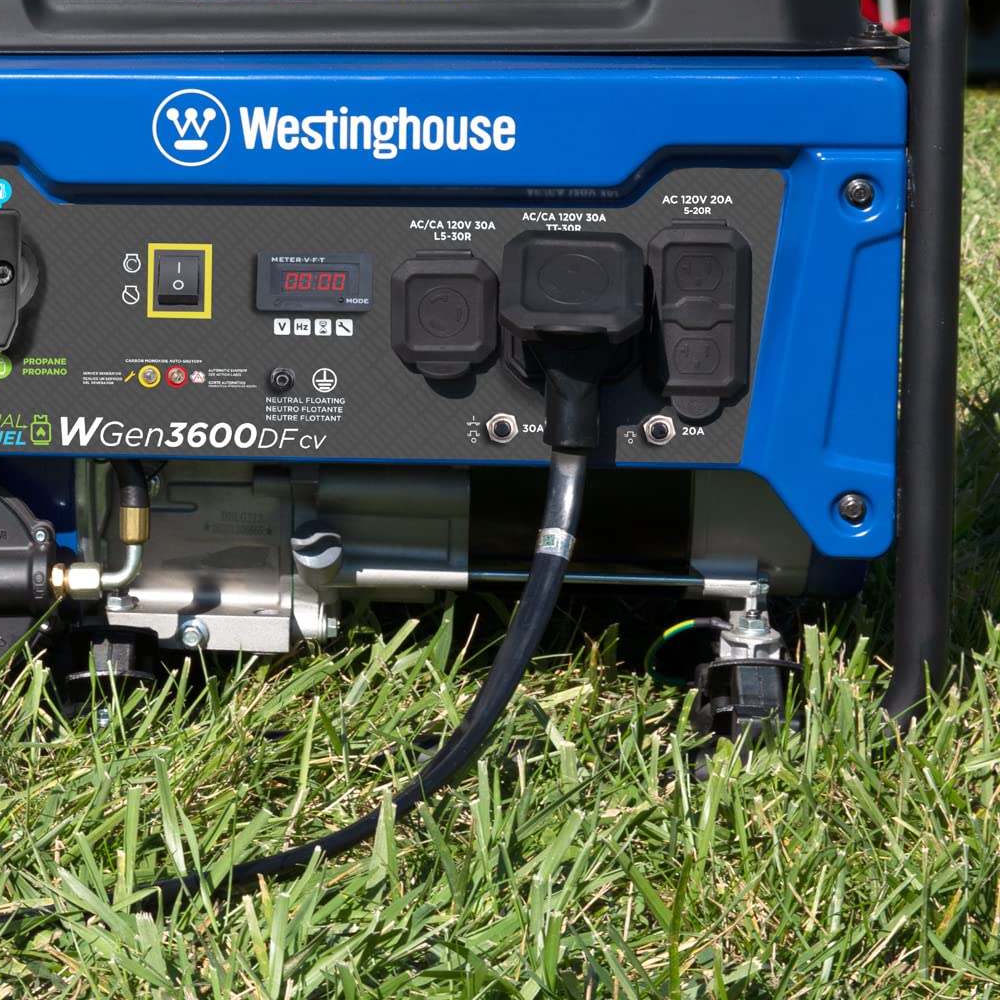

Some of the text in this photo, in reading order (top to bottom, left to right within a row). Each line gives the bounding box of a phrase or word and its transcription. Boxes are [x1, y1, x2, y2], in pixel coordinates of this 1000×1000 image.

[240, 106, 516, 159] Westinghouse
[662, 195, 733, 204] AC 120V 20A
[684, 207, 711, 215] 5-20R
[522, 211, 606, 222] AC/CA 120V 30A
[410, 220, 496, 230] AC/CA 120V 30A
[546, 224, 582, 232] TT-30R
[434, 232, 472, 241] L5-30R
[278, 322, 286, 331] V
[296, 323, 308, 331] Hz
[522, 424, 544, 433] 30A
[682, 427, 705, 436] 20A
